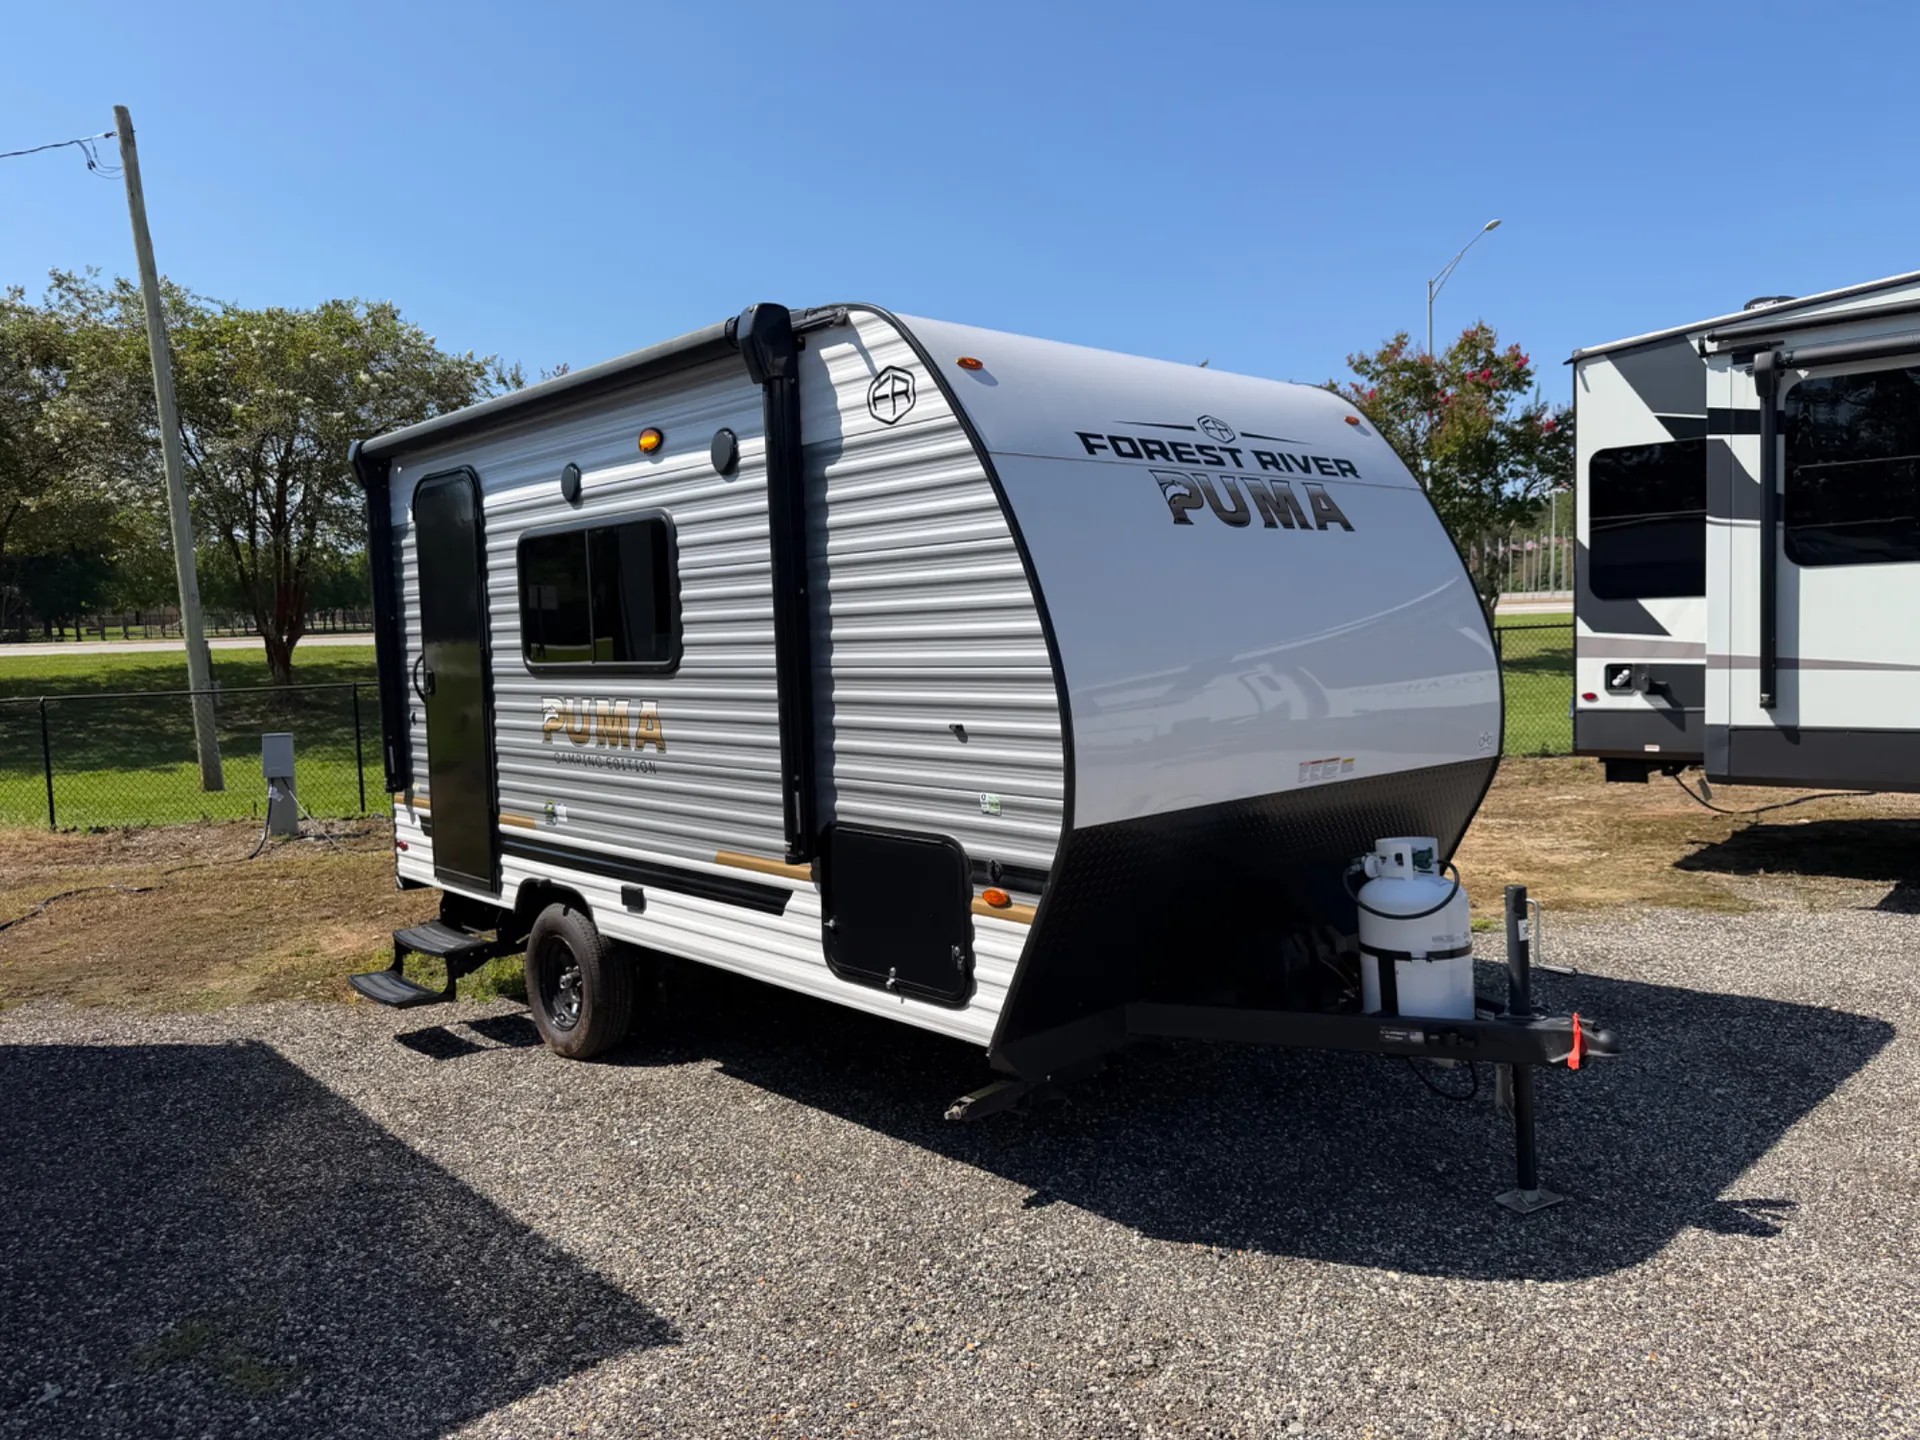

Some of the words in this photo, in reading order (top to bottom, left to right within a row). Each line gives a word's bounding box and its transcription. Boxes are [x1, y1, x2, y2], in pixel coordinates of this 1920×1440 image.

[1074, 431, 1243, 469] FOREST
[1249, 449, 1362, 479] RIVER
[1148, 468, 1356, 532] PUMA
[540, 695, 668, 755] PUMA
[553, 752, 603, 769] CAMPING
[605, 756, 657, 774] EDITION
